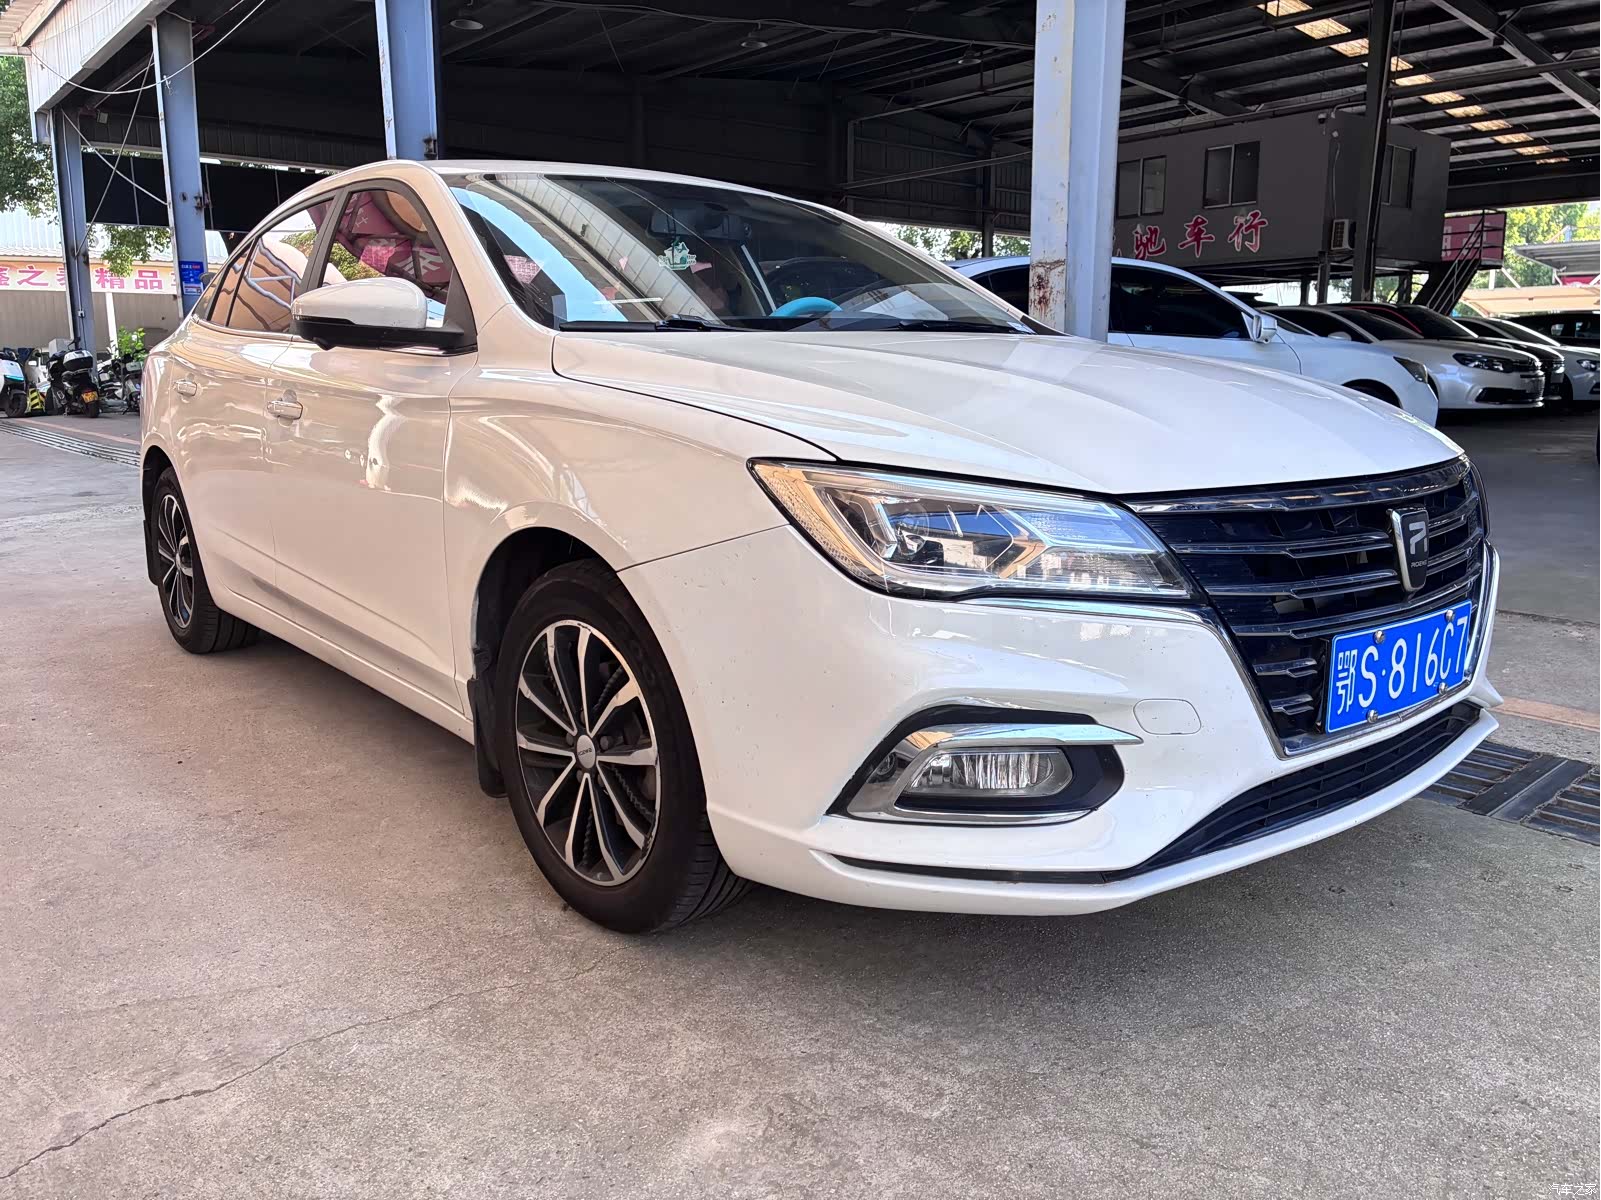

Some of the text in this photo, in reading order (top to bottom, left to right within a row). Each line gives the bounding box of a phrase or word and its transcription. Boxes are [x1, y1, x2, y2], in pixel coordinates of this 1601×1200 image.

[1113, 210, 1268, 260] 驰车行
[0, 265, 176, 290] 之精品
